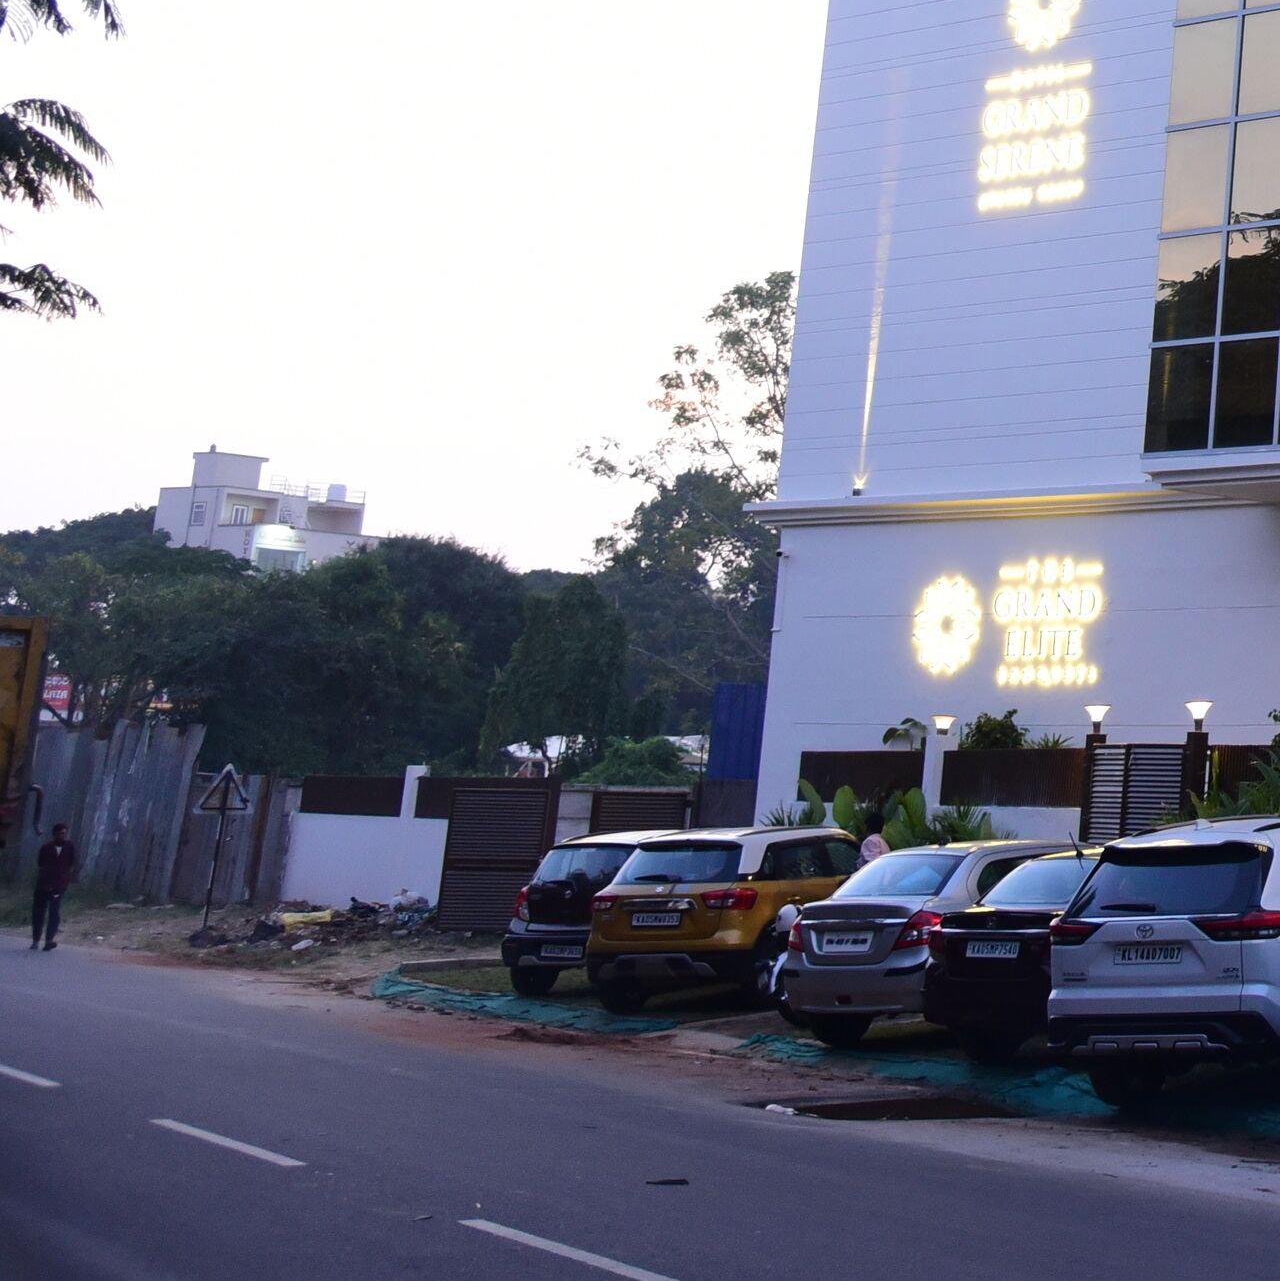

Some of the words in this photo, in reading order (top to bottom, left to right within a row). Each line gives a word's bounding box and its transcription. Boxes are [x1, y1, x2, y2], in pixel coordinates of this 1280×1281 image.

[983, 90, 1087, 136] GRAND
[978, 134, 1085, 181] SERENE
[993, 588, 1097, 618] GRAND
[1003, 628, 1080, 658] ELITE
[1121, 947, 1182, 961] KL14AD7007
